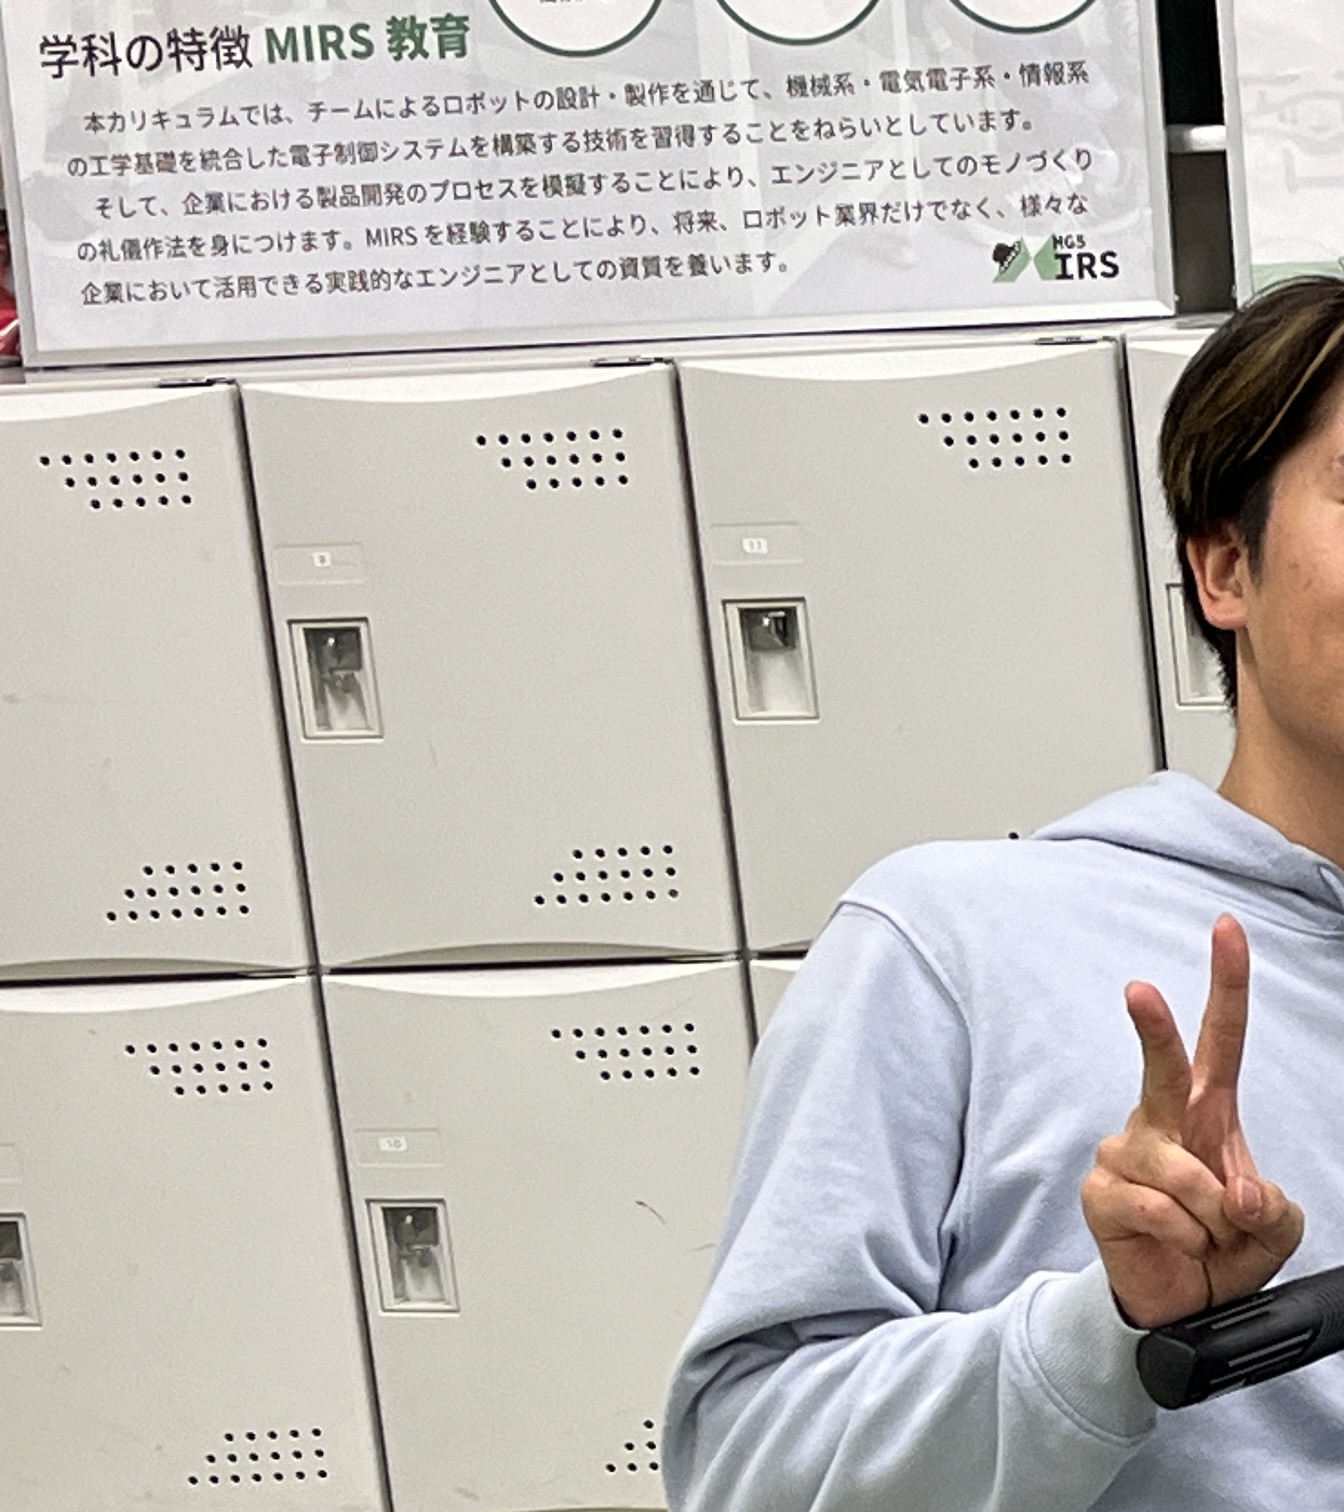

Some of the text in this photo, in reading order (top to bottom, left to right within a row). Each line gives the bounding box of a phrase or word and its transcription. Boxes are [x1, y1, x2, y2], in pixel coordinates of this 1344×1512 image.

[39, 13, 471, 79] 学科の特徴 MIRS 教育
